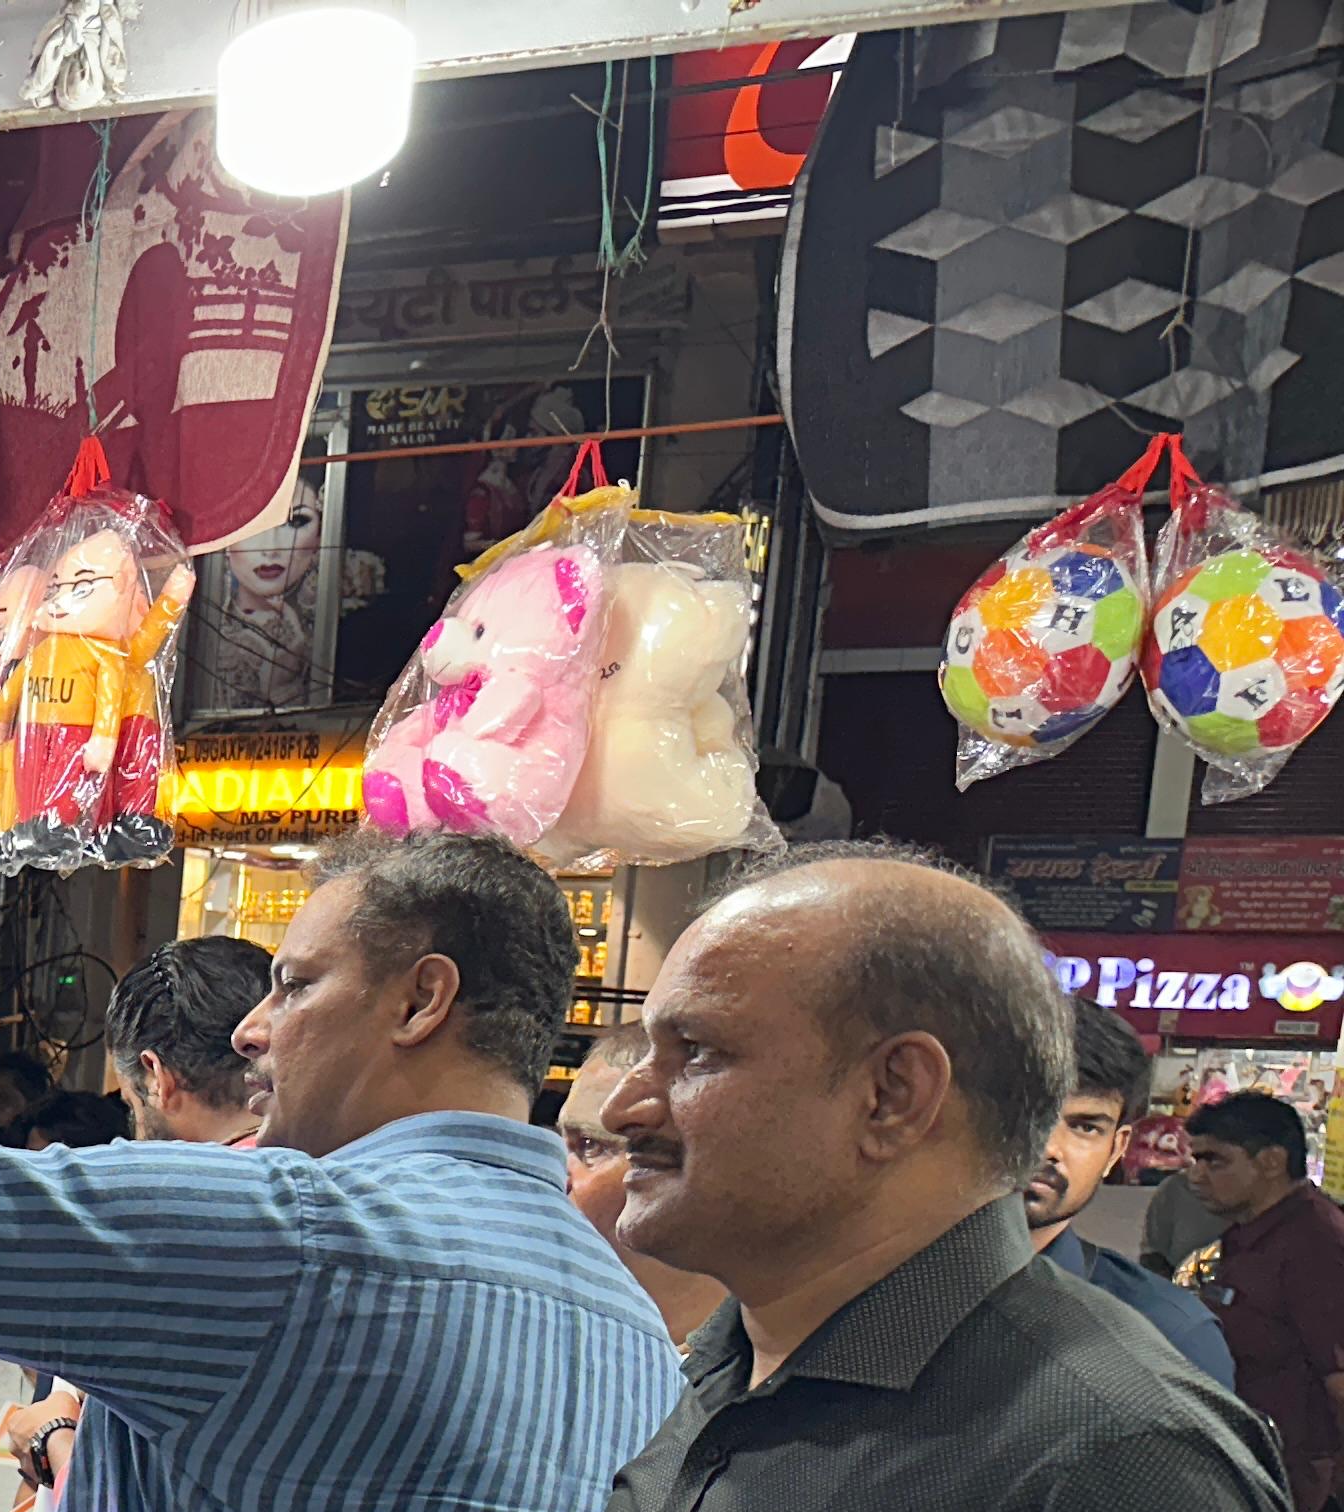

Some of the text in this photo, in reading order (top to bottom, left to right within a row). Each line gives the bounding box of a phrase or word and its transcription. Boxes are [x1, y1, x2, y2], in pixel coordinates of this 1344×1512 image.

[1049, 604, 1089, 636] H
[168, 767, 363, 813] ADIANT
[1095, 956, 1252, 1011] Pizza
